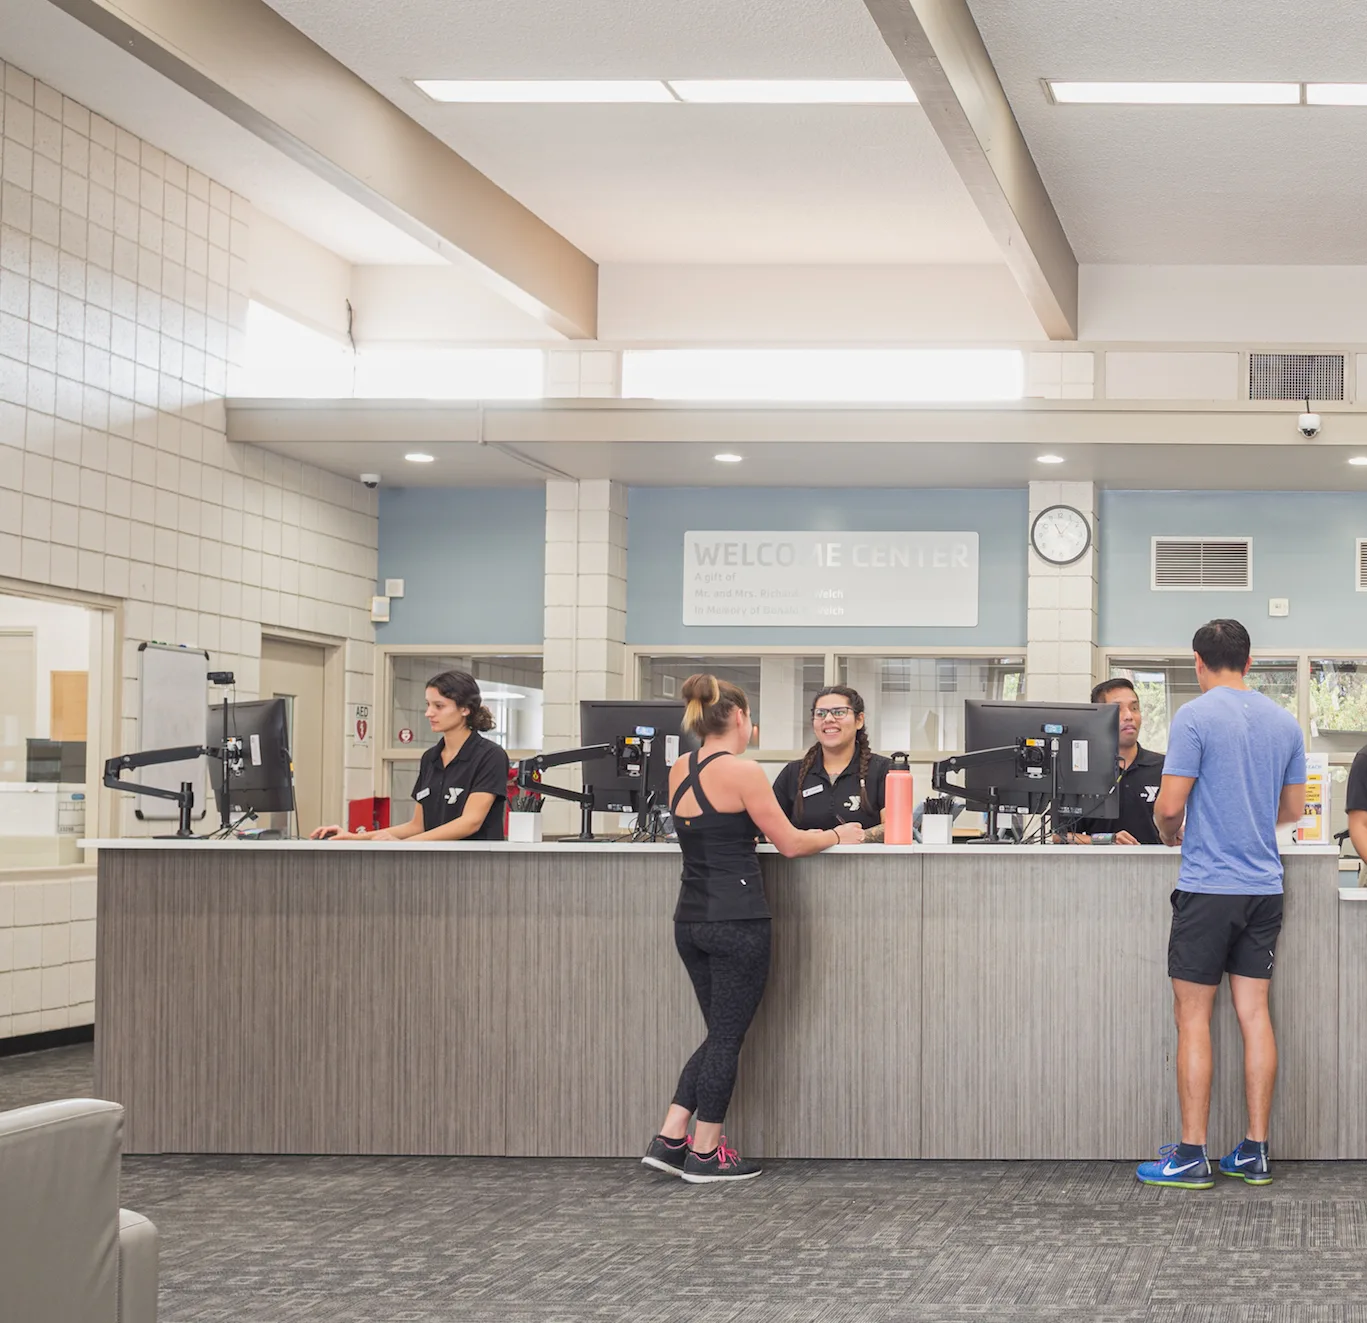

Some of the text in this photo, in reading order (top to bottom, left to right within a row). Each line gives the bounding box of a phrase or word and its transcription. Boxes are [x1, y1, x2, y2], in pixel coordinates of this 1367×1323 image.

[852, 543, 970, 568] CENTER
[694, 572, 737, 584] A gift of
[694, 588, 711, 599] Mr.
[712, 588, 733, 599] and
[734, 588, 758, 599] Mrs.
[694, 605, 704, 616] In
[706, 605, 747, 618] Memory
[750, 605, 761, 616] of
[356, 706, 368, 717] AED
